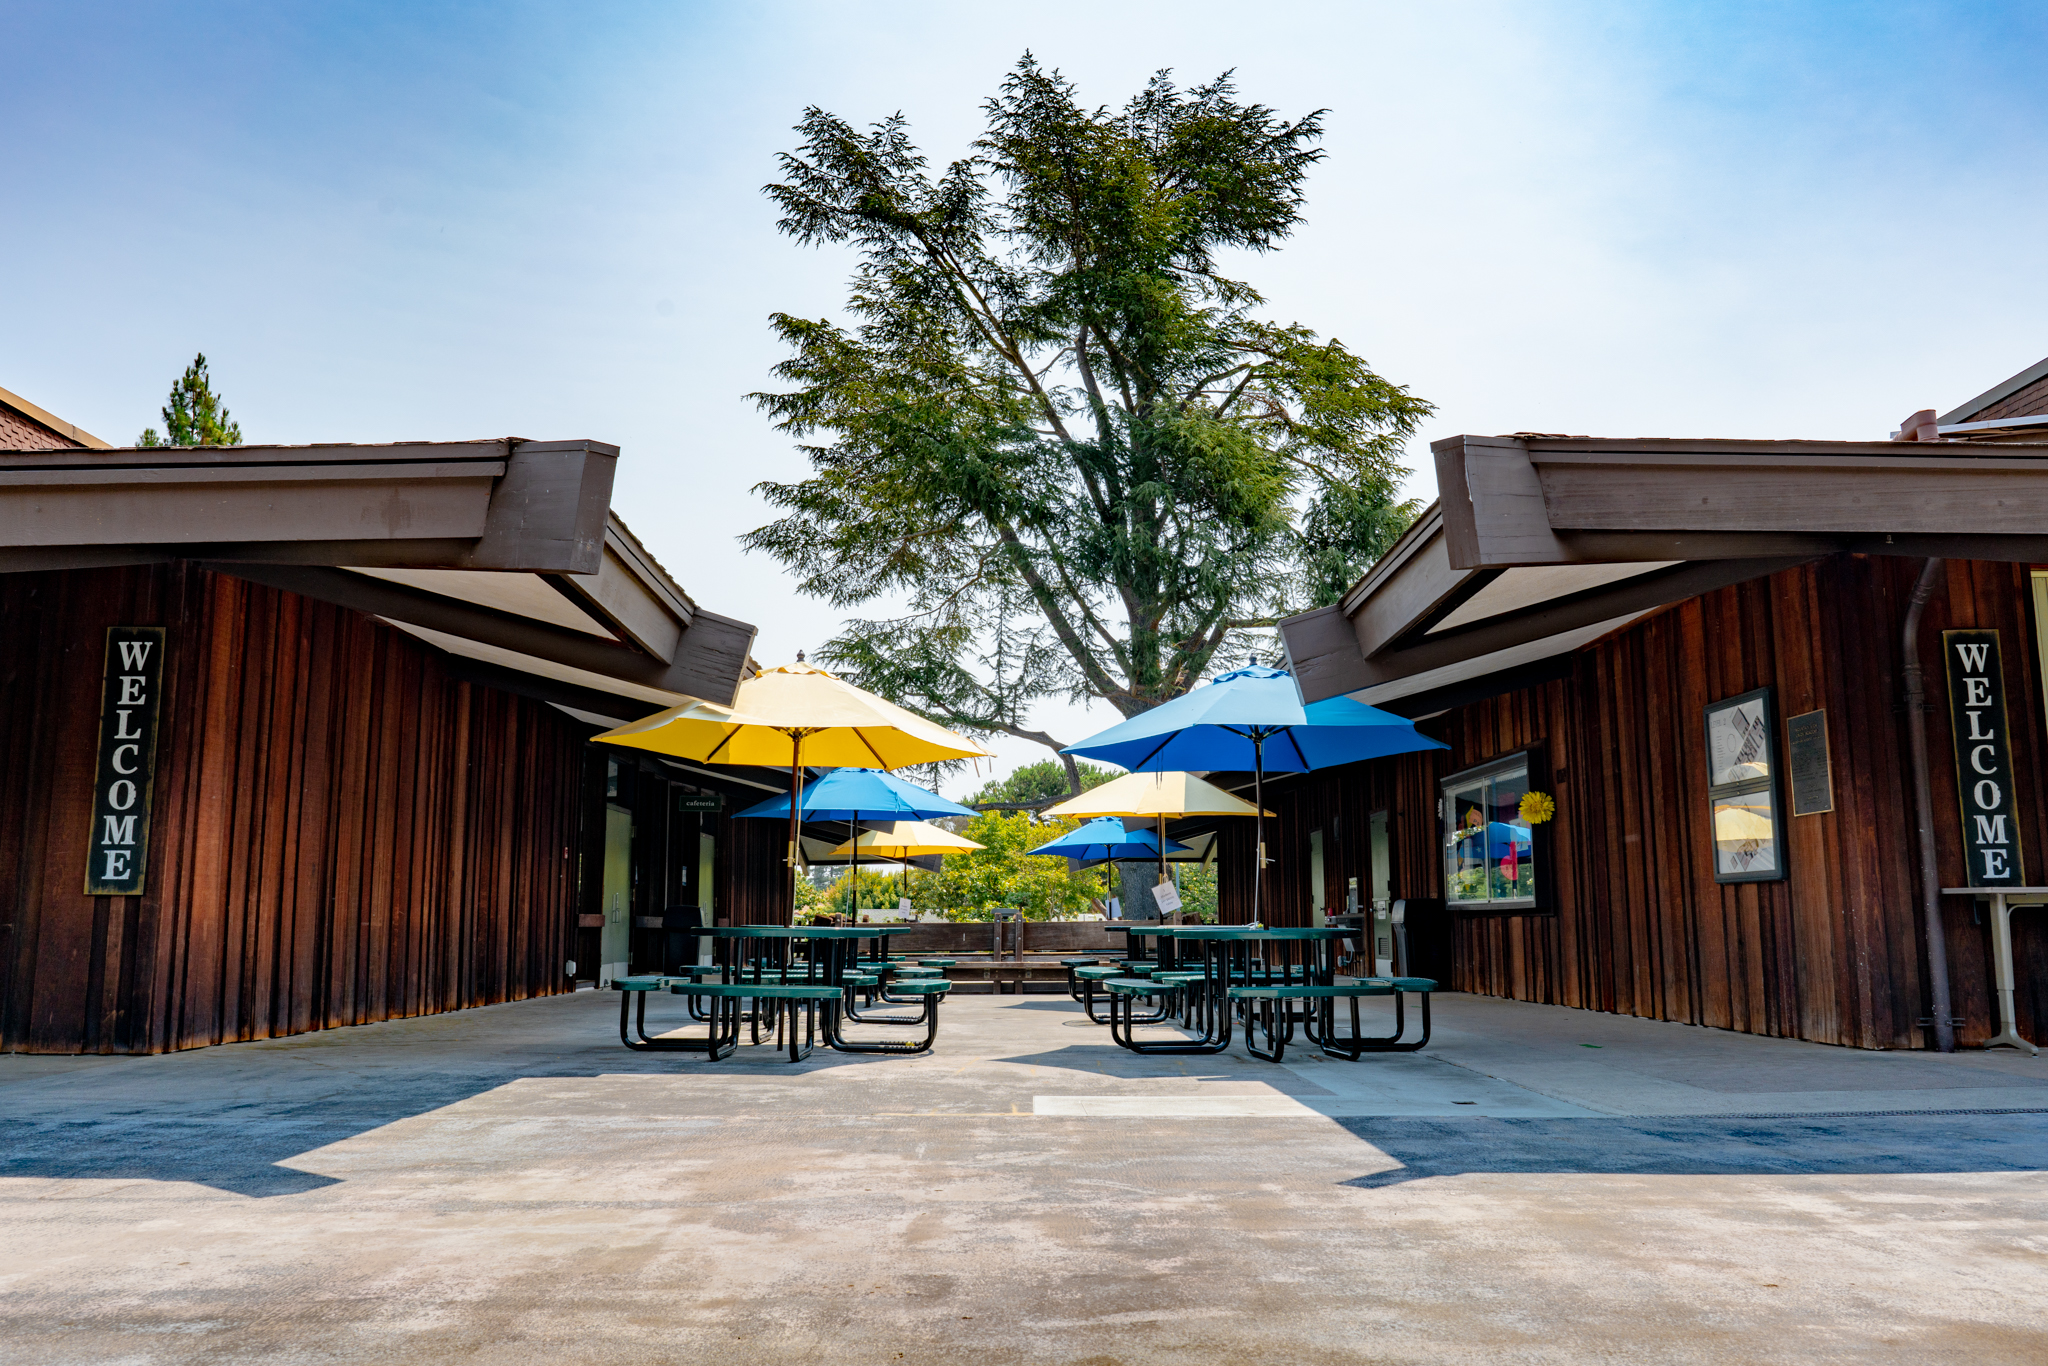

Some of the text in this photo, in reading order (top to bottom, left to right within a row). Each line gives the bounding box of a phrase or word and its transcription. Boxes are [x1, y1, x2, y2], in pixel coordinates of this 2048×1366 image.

[102, 641, 153, 880] WELCOME
[686, 799, 715, 807] cafeteria
[1956, 643, 2010, 879] WELCOME
